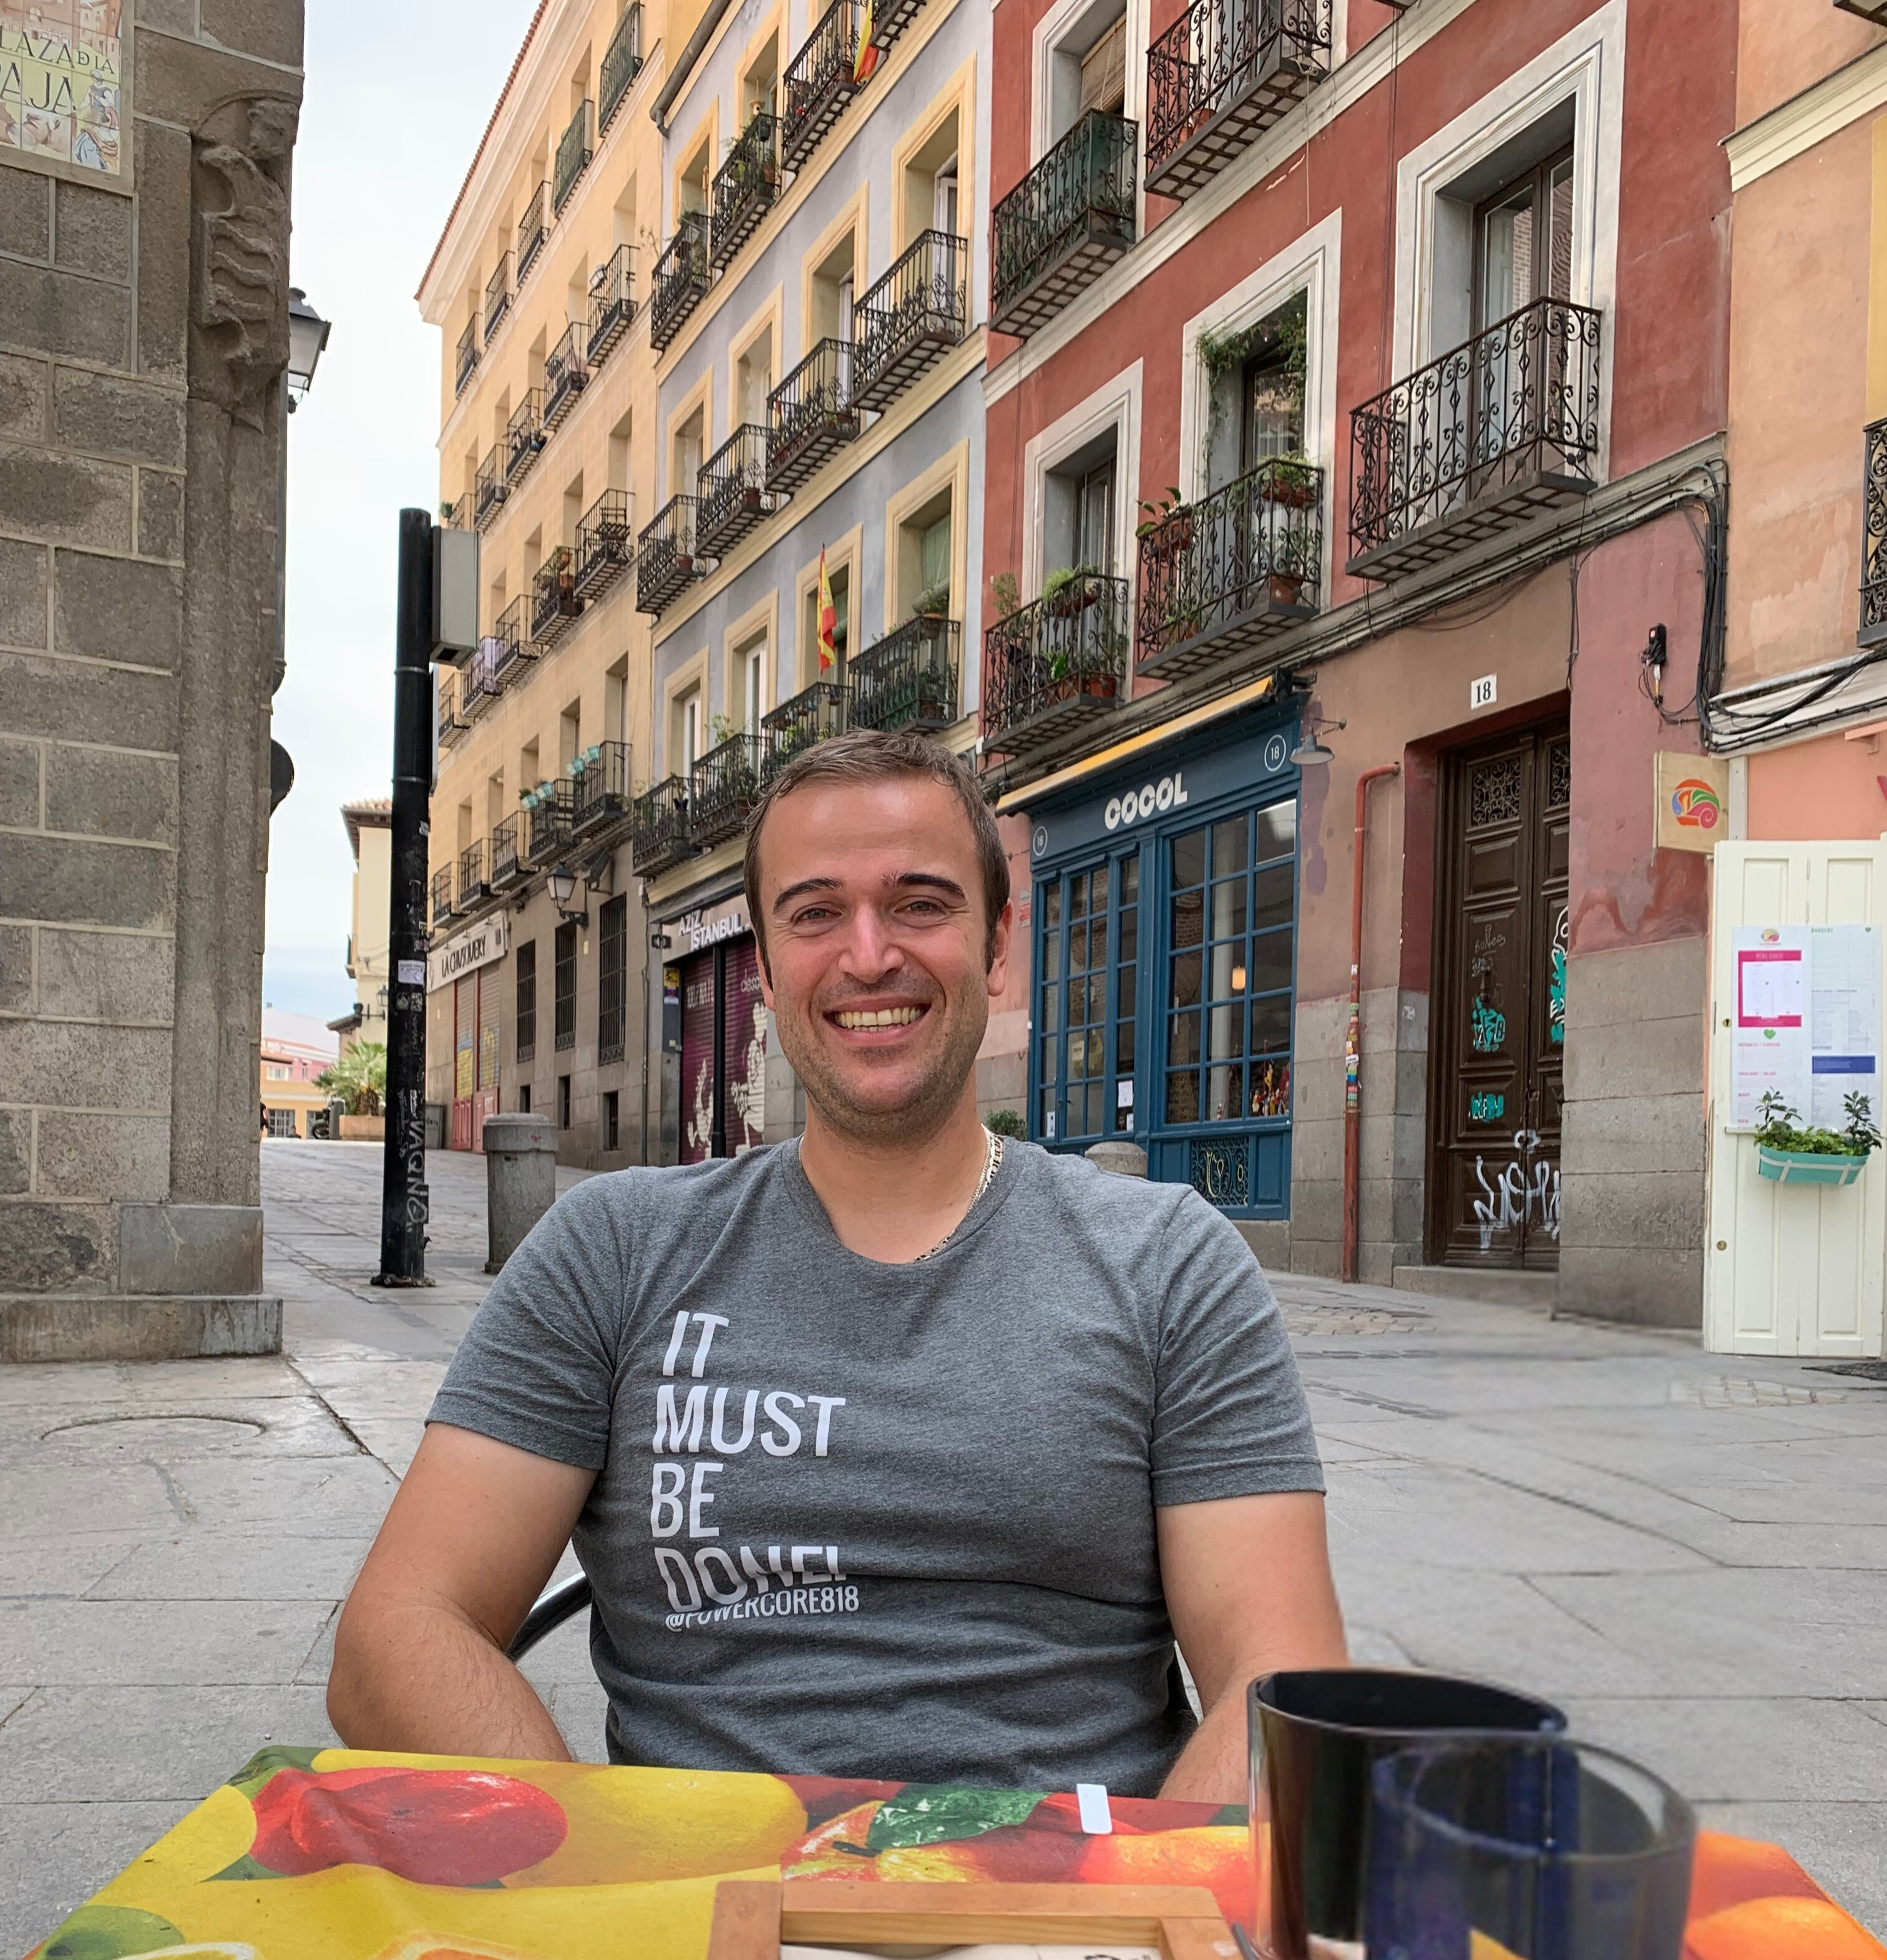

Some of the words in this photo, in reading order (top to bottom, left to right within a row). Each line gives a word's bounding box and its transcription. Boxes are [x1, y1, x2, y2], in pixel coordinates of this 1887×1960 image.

[0, 26, 76, 69] LAZA
[95, 55, 115, 74] LA
[0, 62, 77, 114] AJA
[1476, 680, 1491, 703] 18
[1104, 773, 1188, 830] COCOL
[442, 955, 449, 978] LA
[662, 1310, 730, 1378] IT
[652, 1385, 847, 1457] MUST
[650, 1462, 724, 1538] BE
[654, 1545, 847, 1613] DONE!
